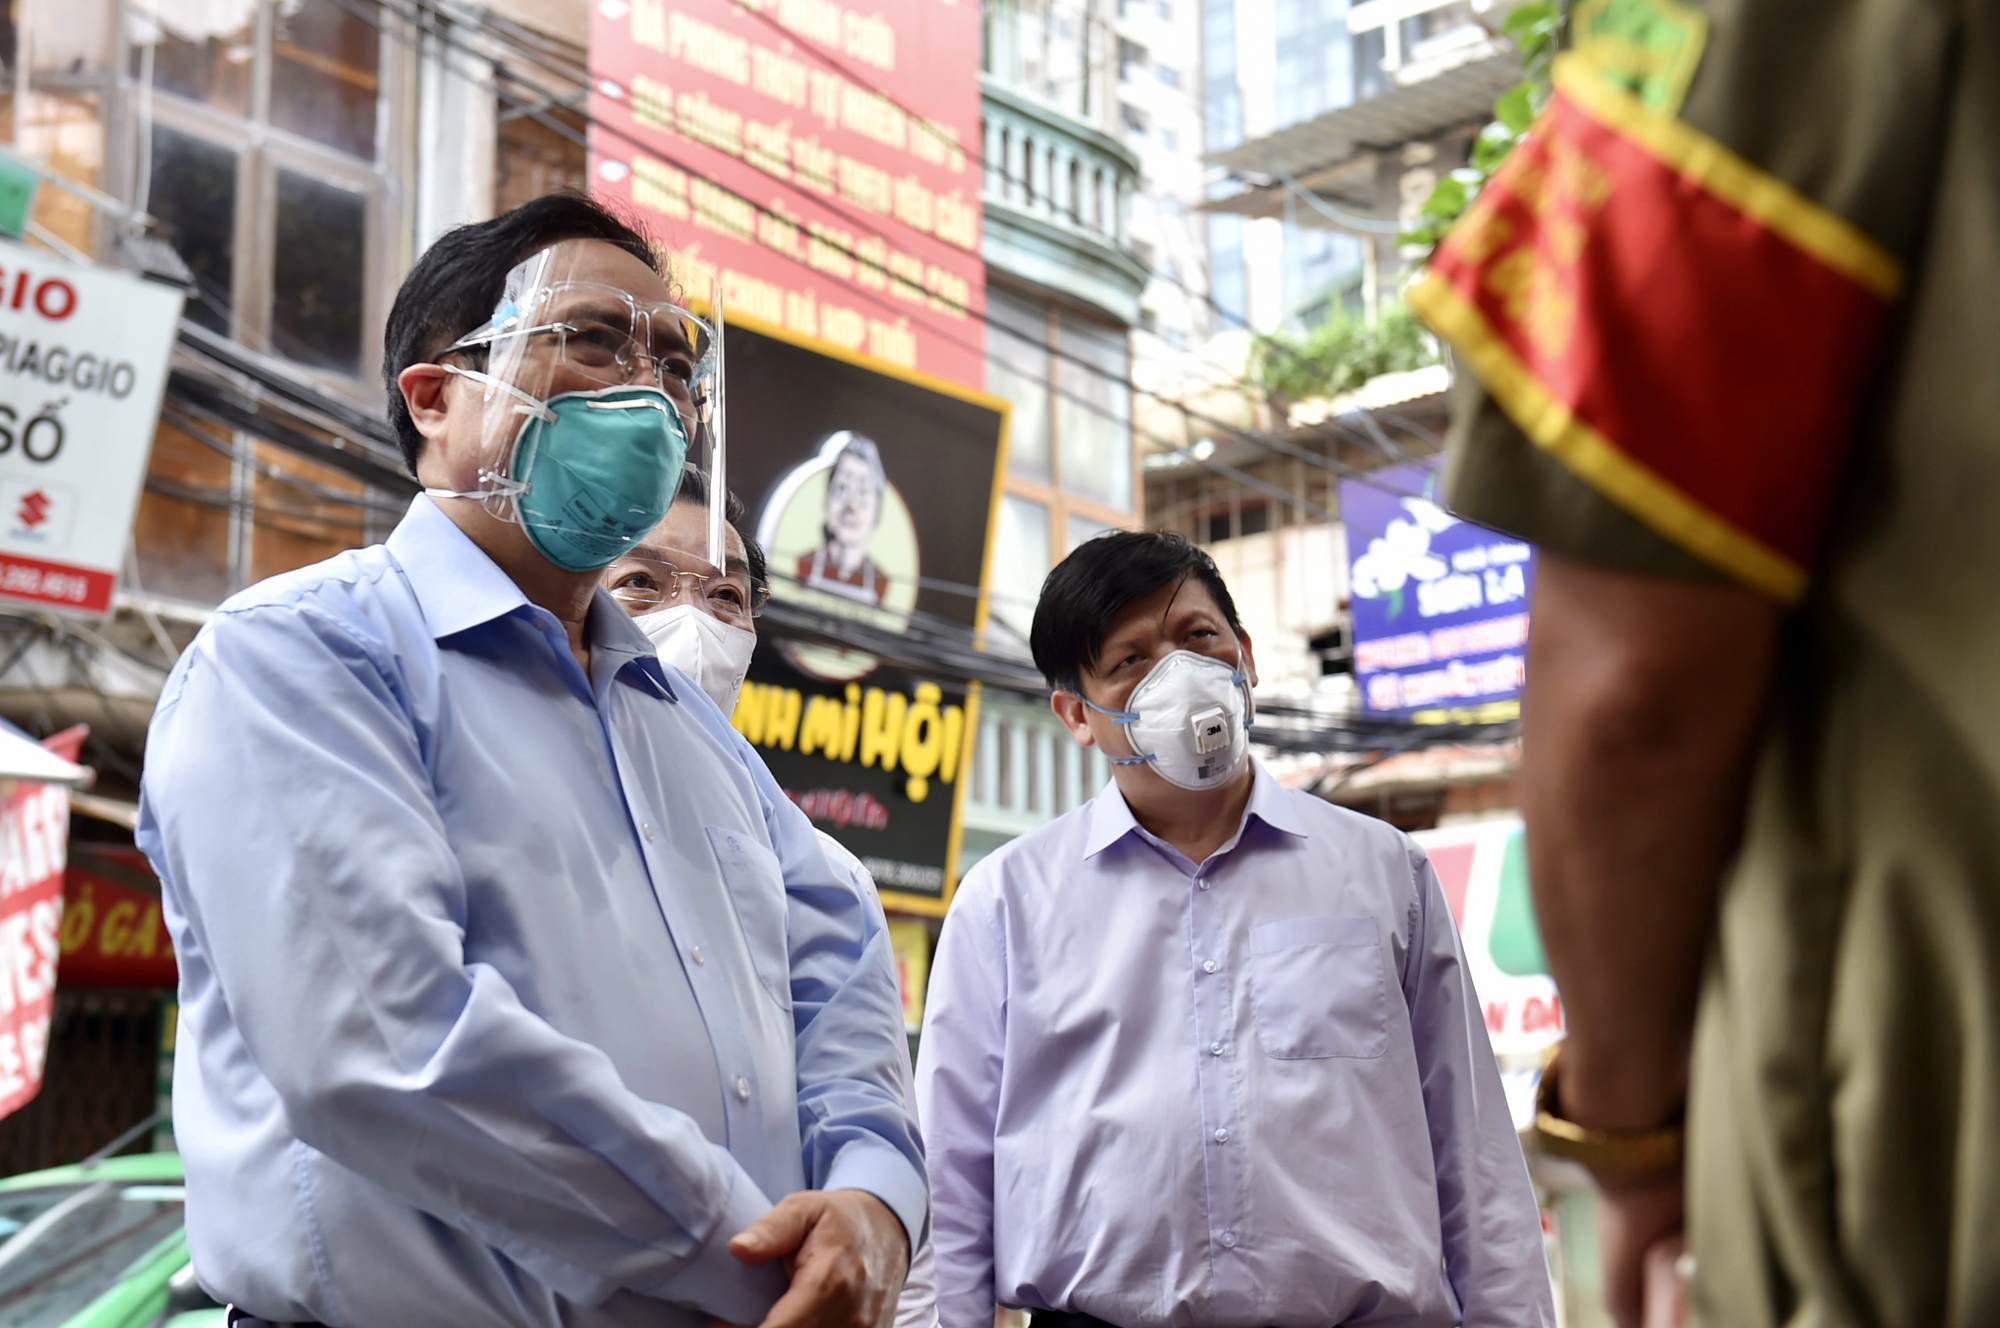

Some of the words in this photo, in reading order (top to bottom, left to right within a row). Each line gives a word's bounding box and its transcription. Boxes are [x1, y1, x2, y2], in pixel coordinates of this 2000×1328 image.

[0, 264, 79, 322] IO
[860, 680, 965, 803] HỘI
[1206, 724, 1222, 737] 3M
